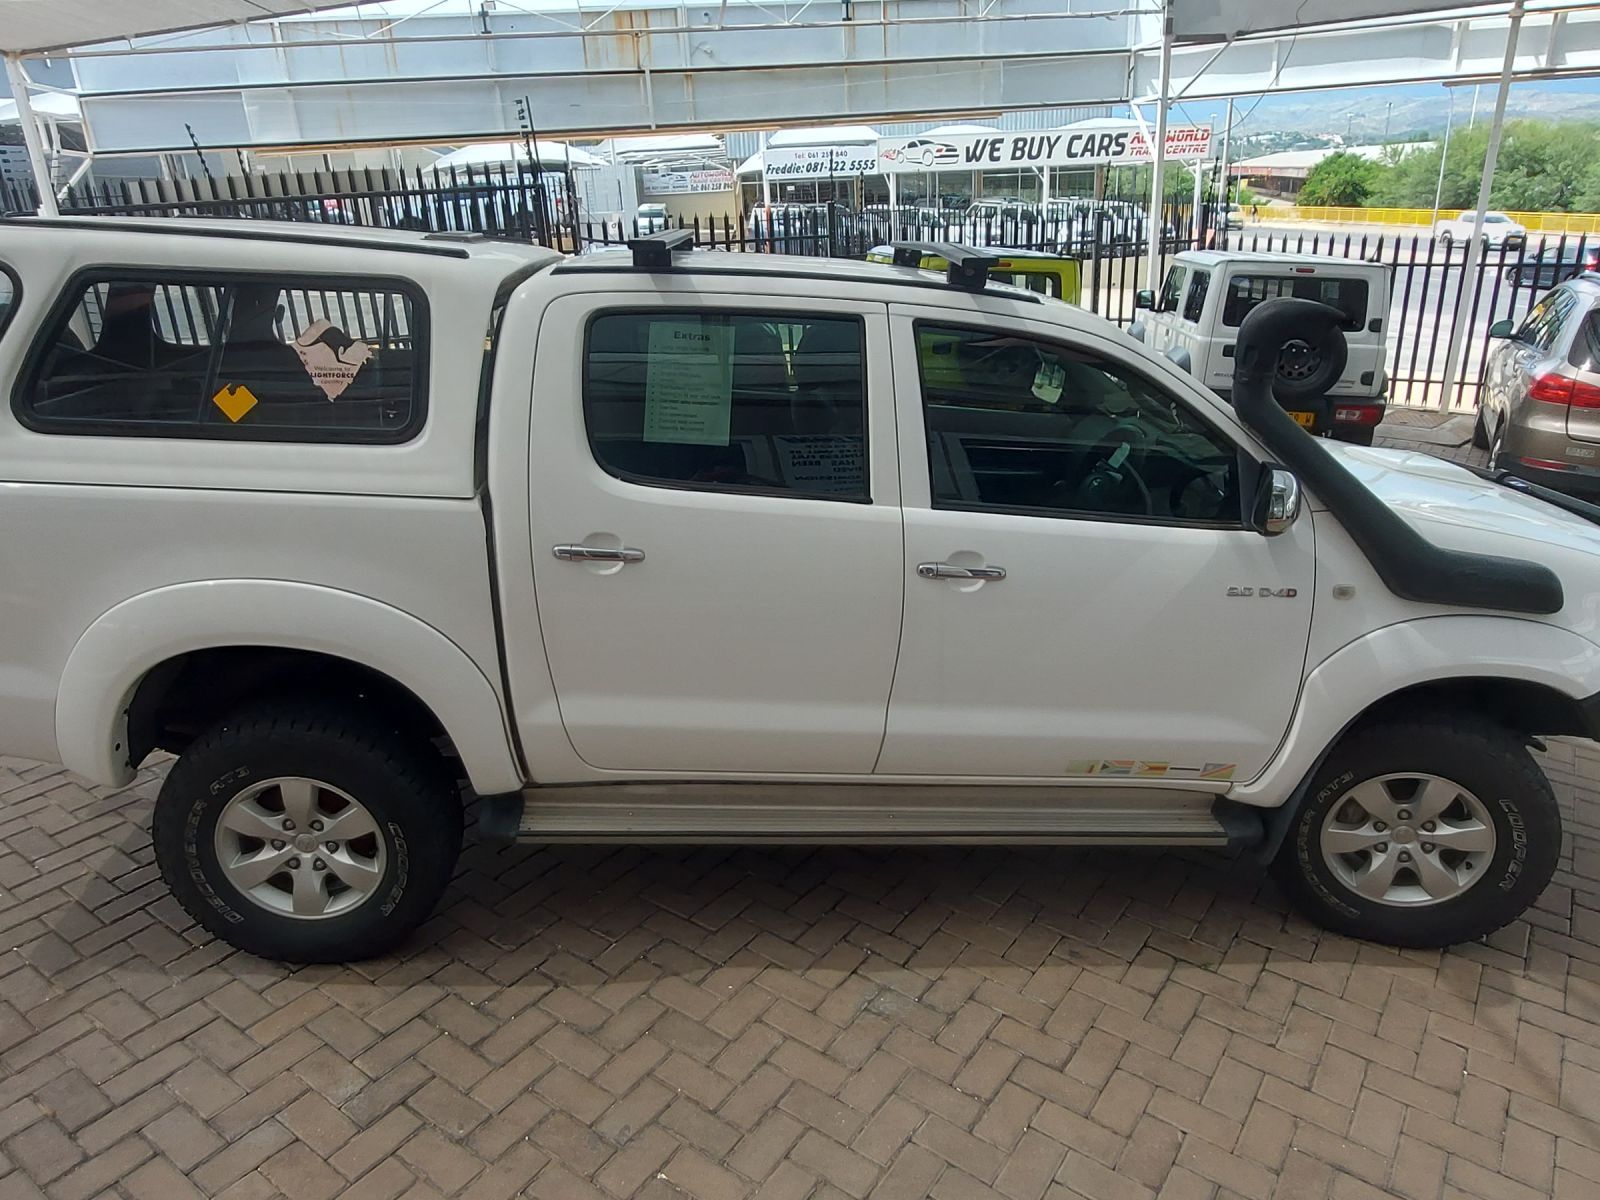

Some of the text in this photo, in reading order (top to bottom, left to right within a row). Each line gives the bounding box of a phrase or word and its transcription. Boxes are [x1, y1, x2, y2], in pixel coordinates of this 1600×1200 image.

[965, 132, 1128, 163] WE BUY CARS
[1166, 144, 1207, 154] CENTRE
[766, 163, 804, 175] Freddie:
[849, 160, 875, 171] 5555
[674, 331, 711, 341] Extras
[1498, 799, 1528, 891] COOPER
[387, 821, 409, 917] COOPER
